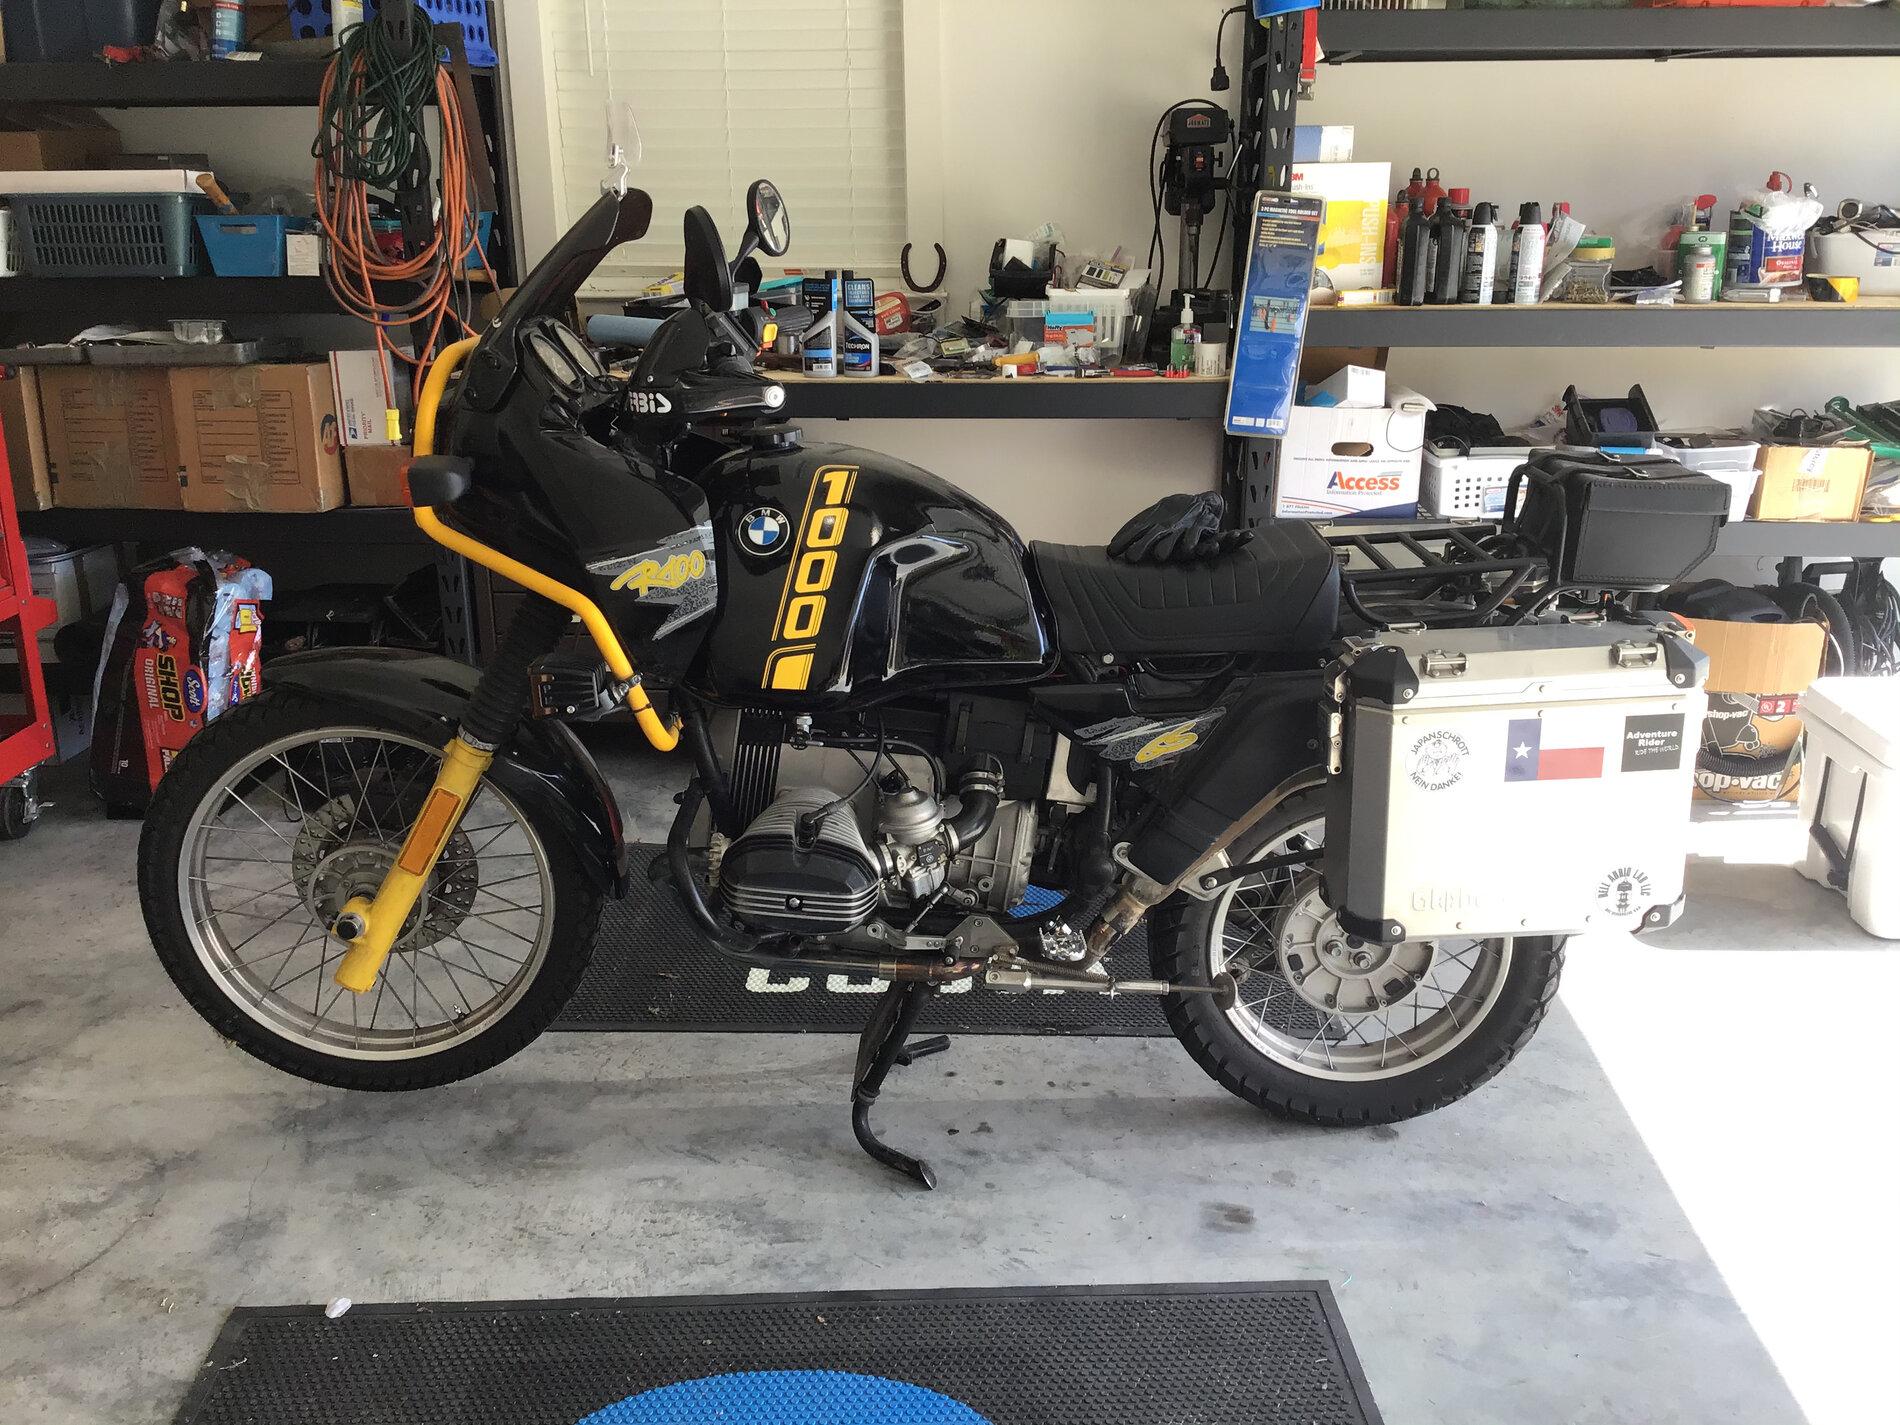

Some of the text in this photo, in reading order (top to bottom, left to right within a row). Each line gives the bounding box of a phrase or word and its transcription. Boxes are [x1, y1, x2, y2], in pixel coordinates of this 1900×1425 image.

[1772, 241, 1802, 253] House
[1327, 471, 1400, 491] Access
[745, 509, 786, 525] BMW
[783, 471, 849, 639] 1000
[144, 658, 160, 709] ORIGINAL
[157, 653, 185, 722] SHOP
[186, 677, 201, 707] Scott
[1776, 700, 1786, 713] 2
[1410, 730, 1470, 756] JAPANSCHROTT
[1626, 730, 1678, 739] Adventure
[1638, 739, 1665, 747] Rider
[1410, 771, 1429, 790] NEIN
